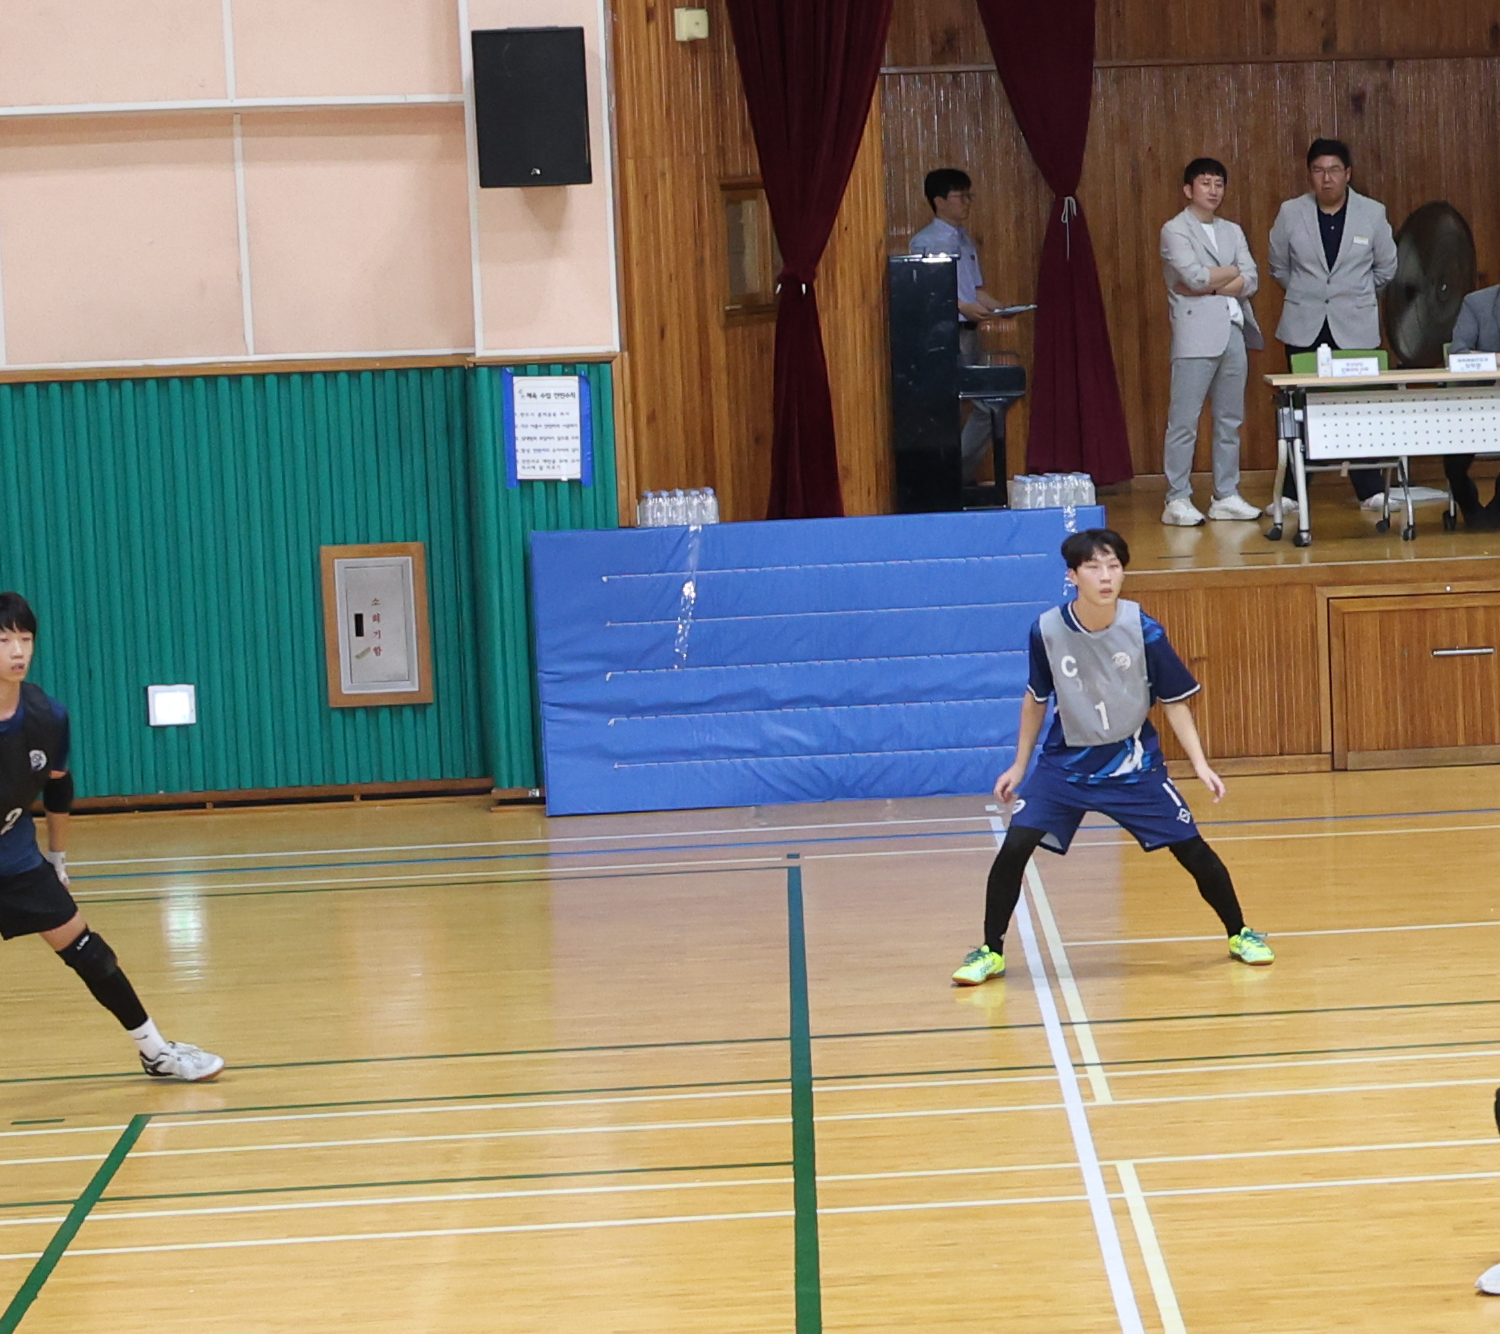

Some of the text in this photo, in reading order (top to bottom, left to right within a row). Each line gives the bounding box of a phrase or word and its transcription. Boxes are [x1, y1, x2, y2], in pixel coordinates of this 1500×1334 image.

[1061, 655, 1079, 678] C
[1094, 700, 1110, 731] 1
[0, 807, 23, 836] 2
